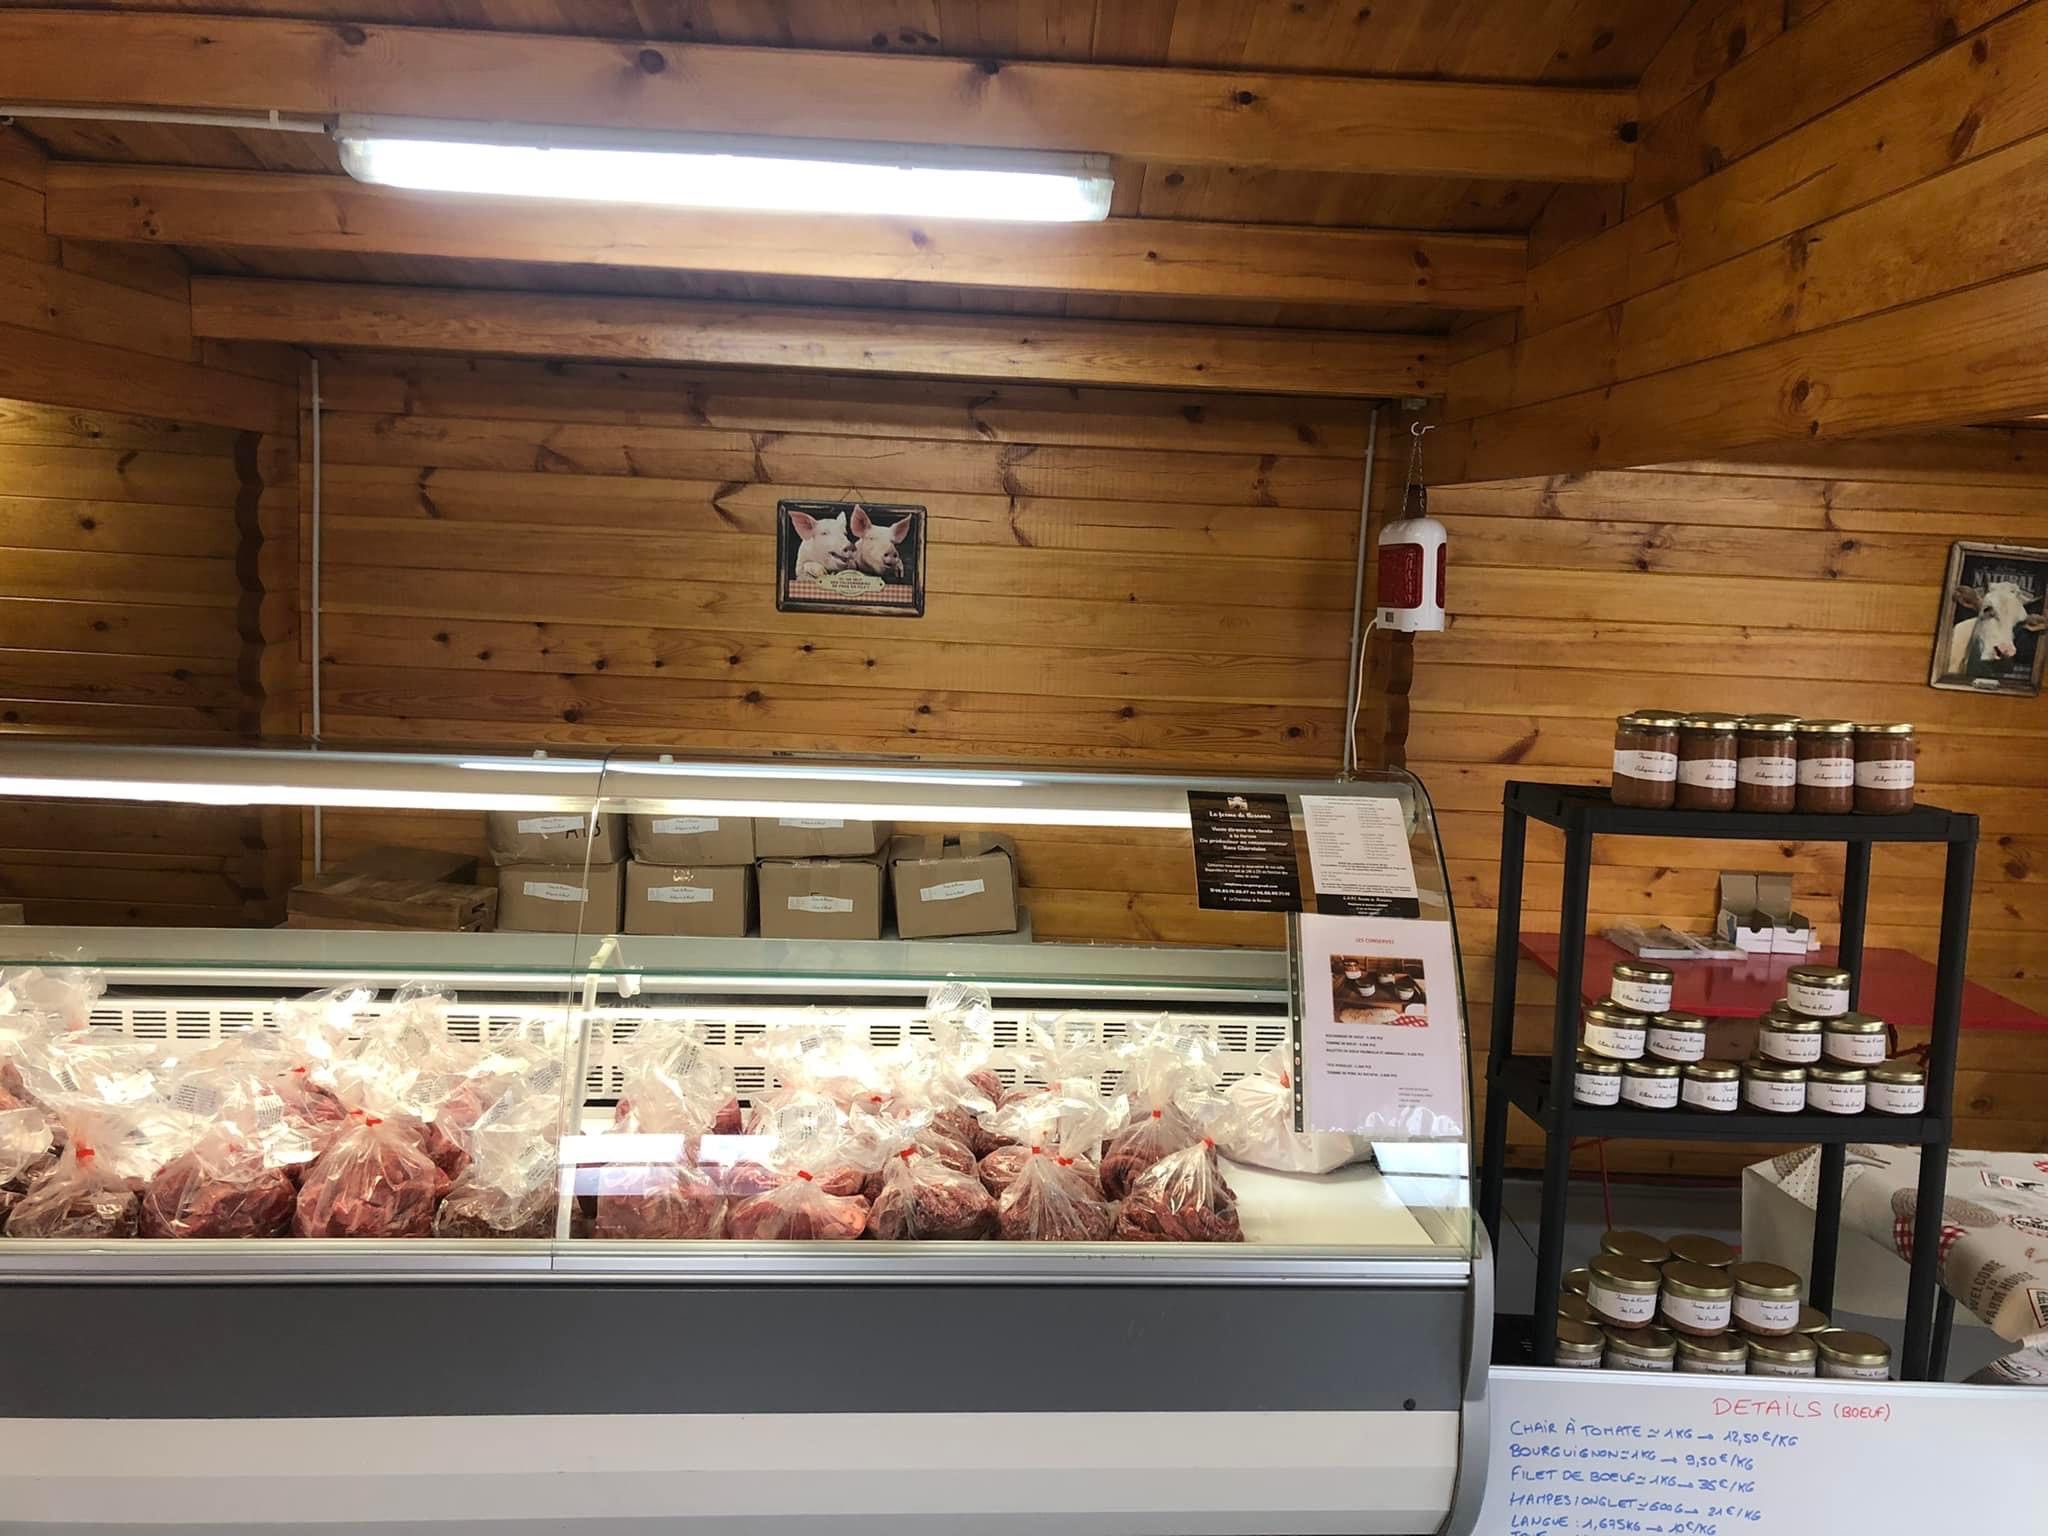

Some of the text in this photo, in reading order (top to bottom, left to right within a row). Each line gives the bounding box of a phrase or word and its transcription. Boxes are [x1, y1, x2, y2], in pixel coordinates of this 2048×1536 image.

[1833, 1403, 1891, 1422] (BOEUF)
[1580, 1424, 1642, 1438] TOMATE
[1509, 1443, 1619, 1458] BOURGUIGNON
[1511, 1465, 1558, 1481] FILET
[1562, 1470, 1585, 1481] DE
[1511, 1514, 1568, 1529] LANGUE
